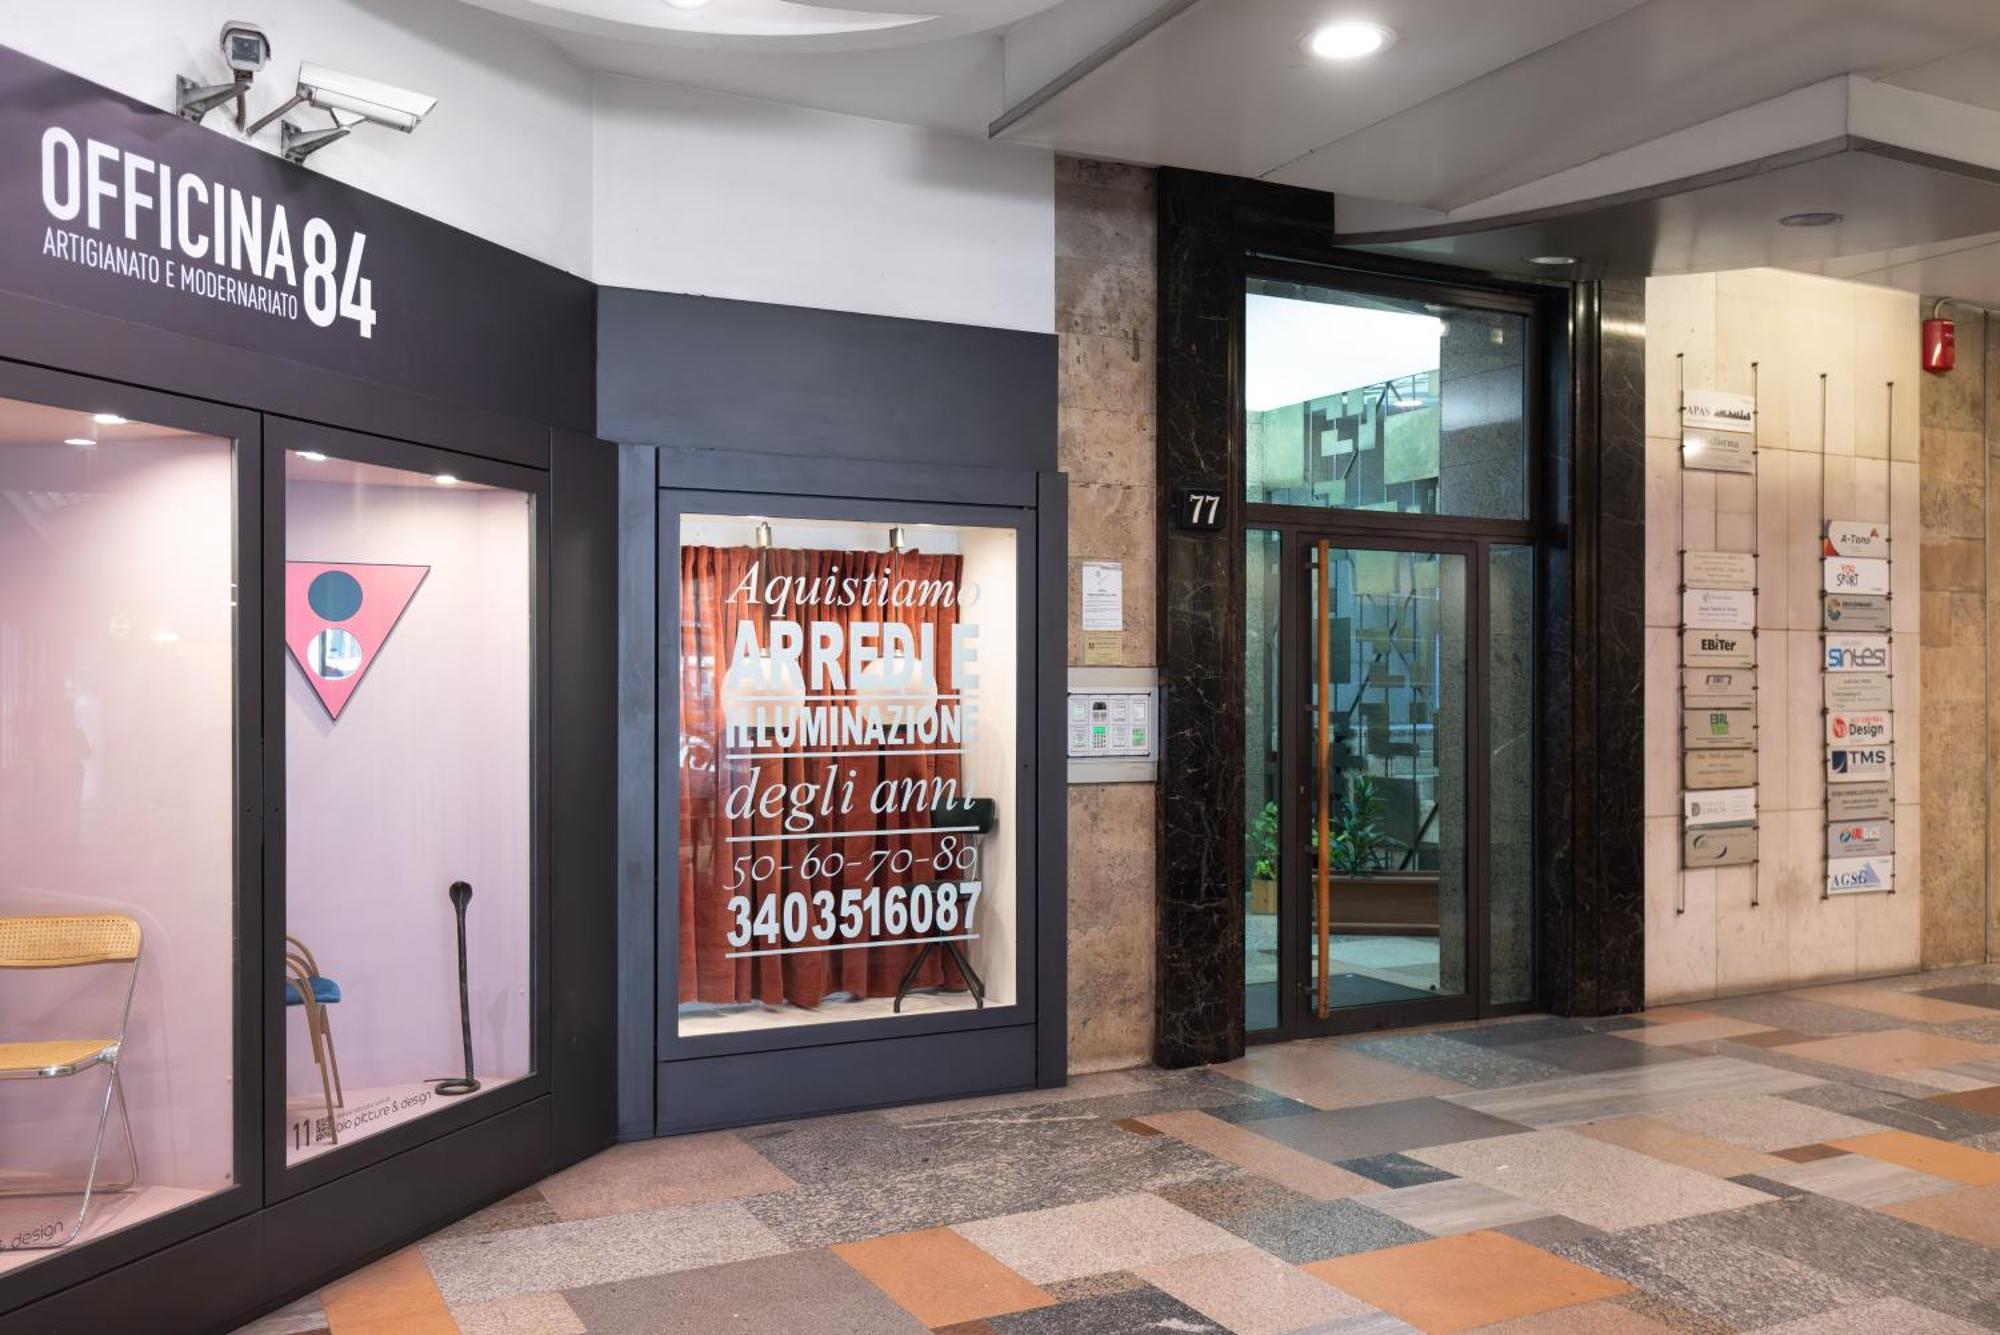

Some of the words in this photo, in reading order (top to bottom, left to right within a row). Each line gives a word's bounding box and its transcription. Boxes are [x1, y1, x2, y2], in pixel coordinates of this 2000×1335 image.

[42, 126, 297, 286] OFFICINA
[303, 217, 377, 339] 84
[43, 227, 160, 283] ARTIGIANATO
[166, 260, 175, 289] E
[181, 264, 298, 320] MODERNARIATO
[1190, 494, 1220, 525] 77
[725, 560, 981, 617] Aquistiamo
[727, 620, 934, 691] ARREDI
[951, 624, 980, 690] E
[726, 703, 980, 748] ILLUMINAZIONE
[1849, 723, 1884, 738] Design
[1849, 750, 1887, 764] TMS
[725, 765, 855, 832] degli
[870, 772, 976, 813] anni
[727, 881, 982, 948] 3403516087
